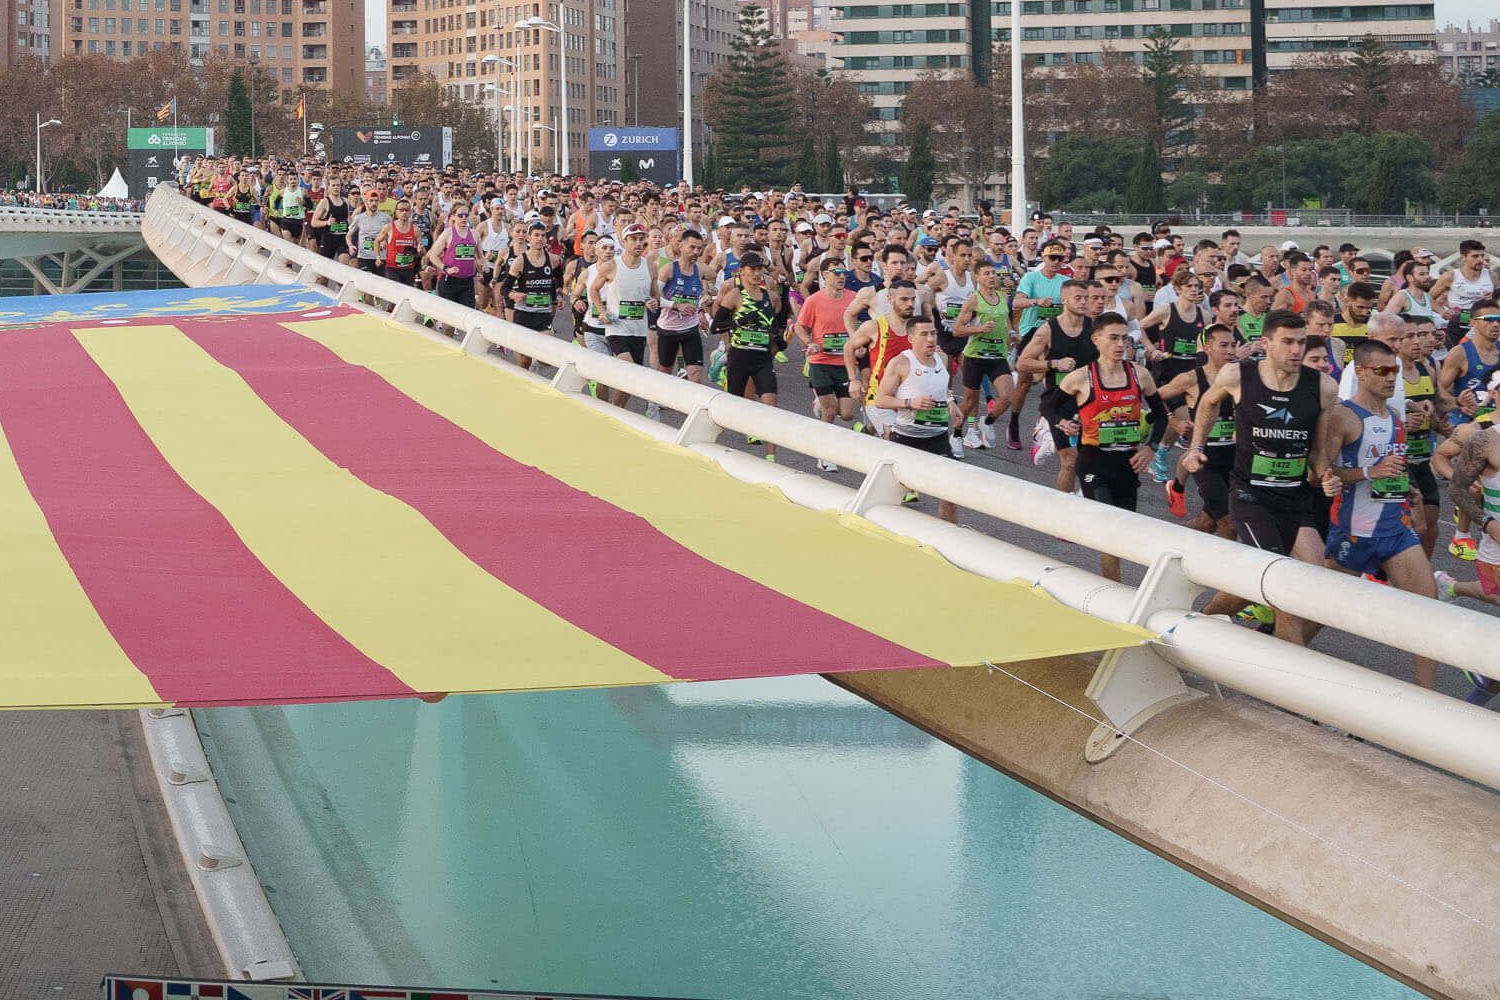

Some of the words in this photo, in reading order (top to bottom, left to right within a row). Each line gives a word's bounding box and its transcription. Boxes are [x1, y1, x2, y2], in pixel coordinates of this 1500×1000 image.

[621, 135, 659, 144] ZURICH
[1252, 426, 1309, 441] RUNNER'S
[1364, 442, 1409, 458] ALPES
